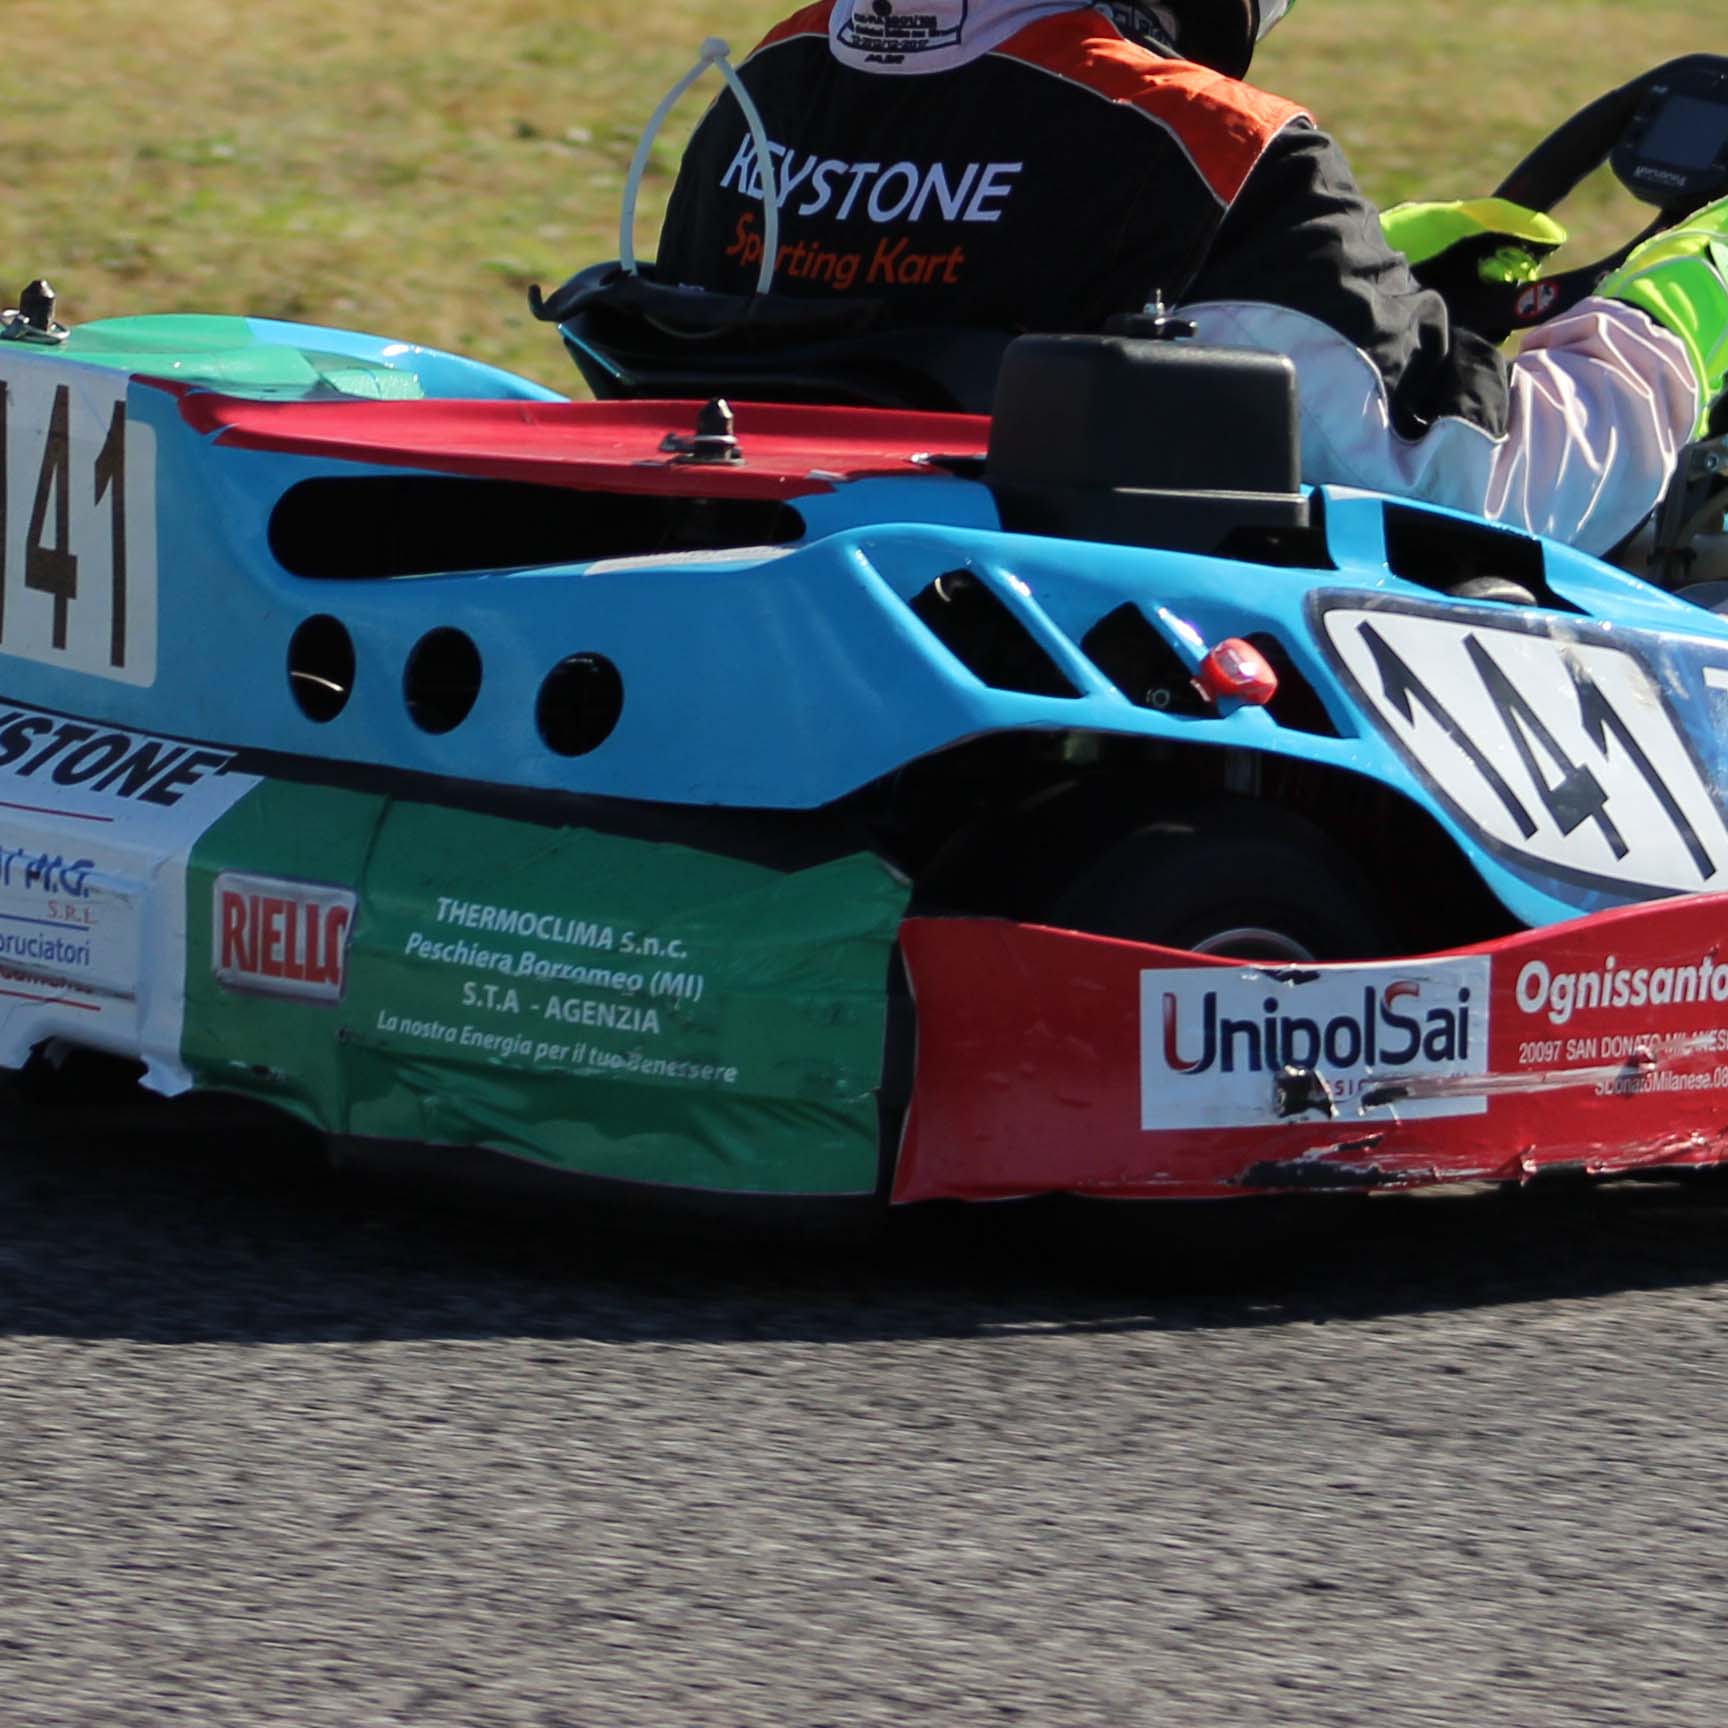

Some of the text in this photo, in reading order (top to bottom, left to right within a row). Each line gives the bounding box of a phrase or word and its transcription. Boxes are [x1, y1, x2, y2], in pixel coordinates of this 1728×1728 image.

[720, 132, 1023, 222] KEYSTONE
[725, 210, 966, 290] Sprting Kart
[1356, 619, 1716, 882] 141
[436, 896, 615, 951] THERMOCLIMA
[404, 931, 514, 974] Peschiera
[649, 969, 705, 1003] (MI)
[377, 1009, 396, 1032] La
[398, 1019, 457, 1045] nostra
[459, 1025, 533, 1058] Energia
[533, 1041, 571, 1065] per
[462, 980, 520, 1014] S.T.A
[544, 995, 661, 1035] AGENZIA
[1162, 981, 1471, 1075] UnipolSai
[1519, 1040, 1562, 1065] 20097
[1565, 1038, 1598, 1060] SAN
